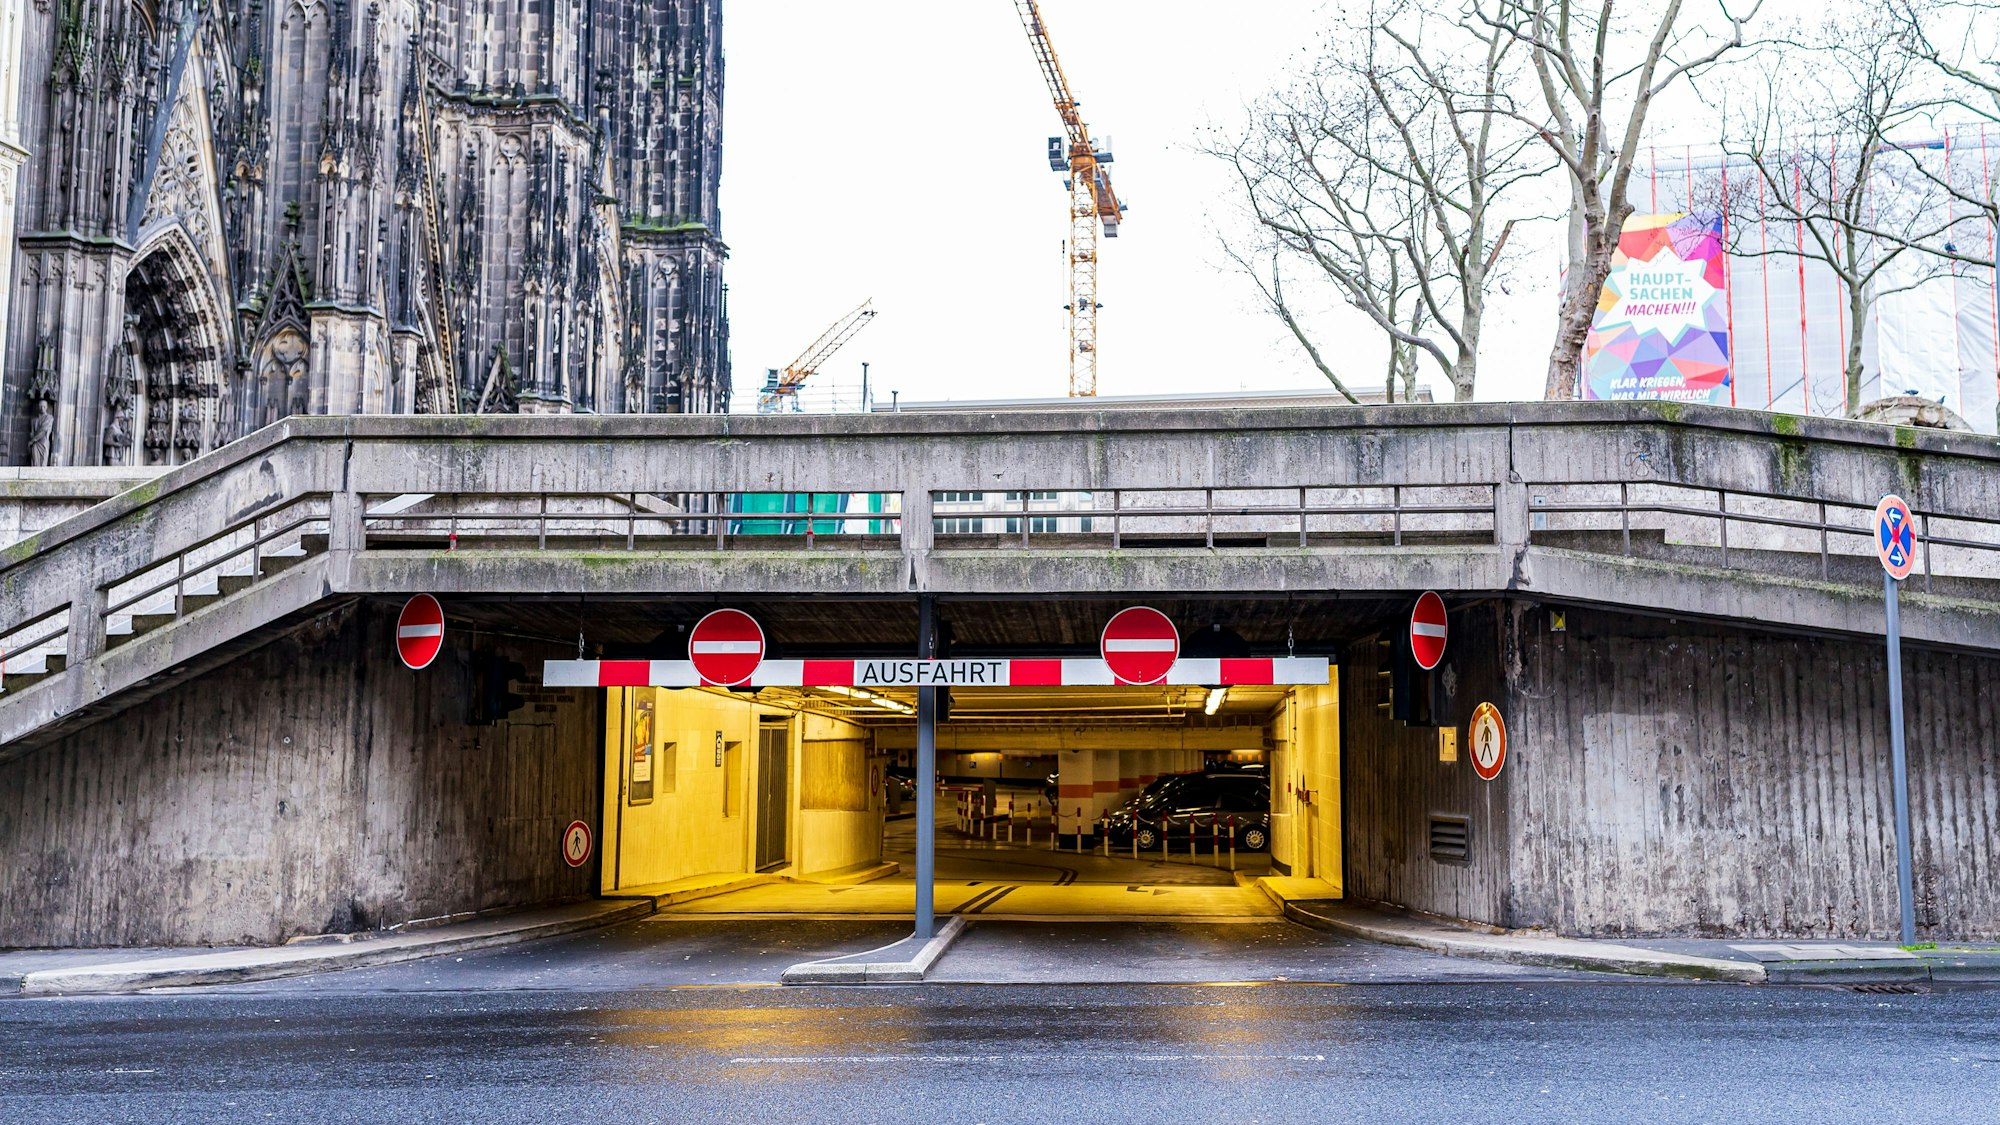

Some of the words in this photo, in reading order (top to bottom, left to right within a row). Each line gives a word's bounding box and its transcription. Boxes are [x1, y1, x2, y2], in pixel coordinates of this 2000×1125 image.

[1630, 273, 1691, 285] HAUPT-
[1630, 287, 1692, 300] SACHEN
[1625, 302, 1696, 316] MACHEN!!!
[1610, 378, 1636, 389] KLAR
[1640, 376, 1686, 388] KRIEGEN,
[1611, 391, 1635, 400] WAS
[1637, 390, 1658, 400] MIR
[1660, 389, 1711, 400] WIRKLICH
[862, 662, 1001, 683] AUSFAHRT
